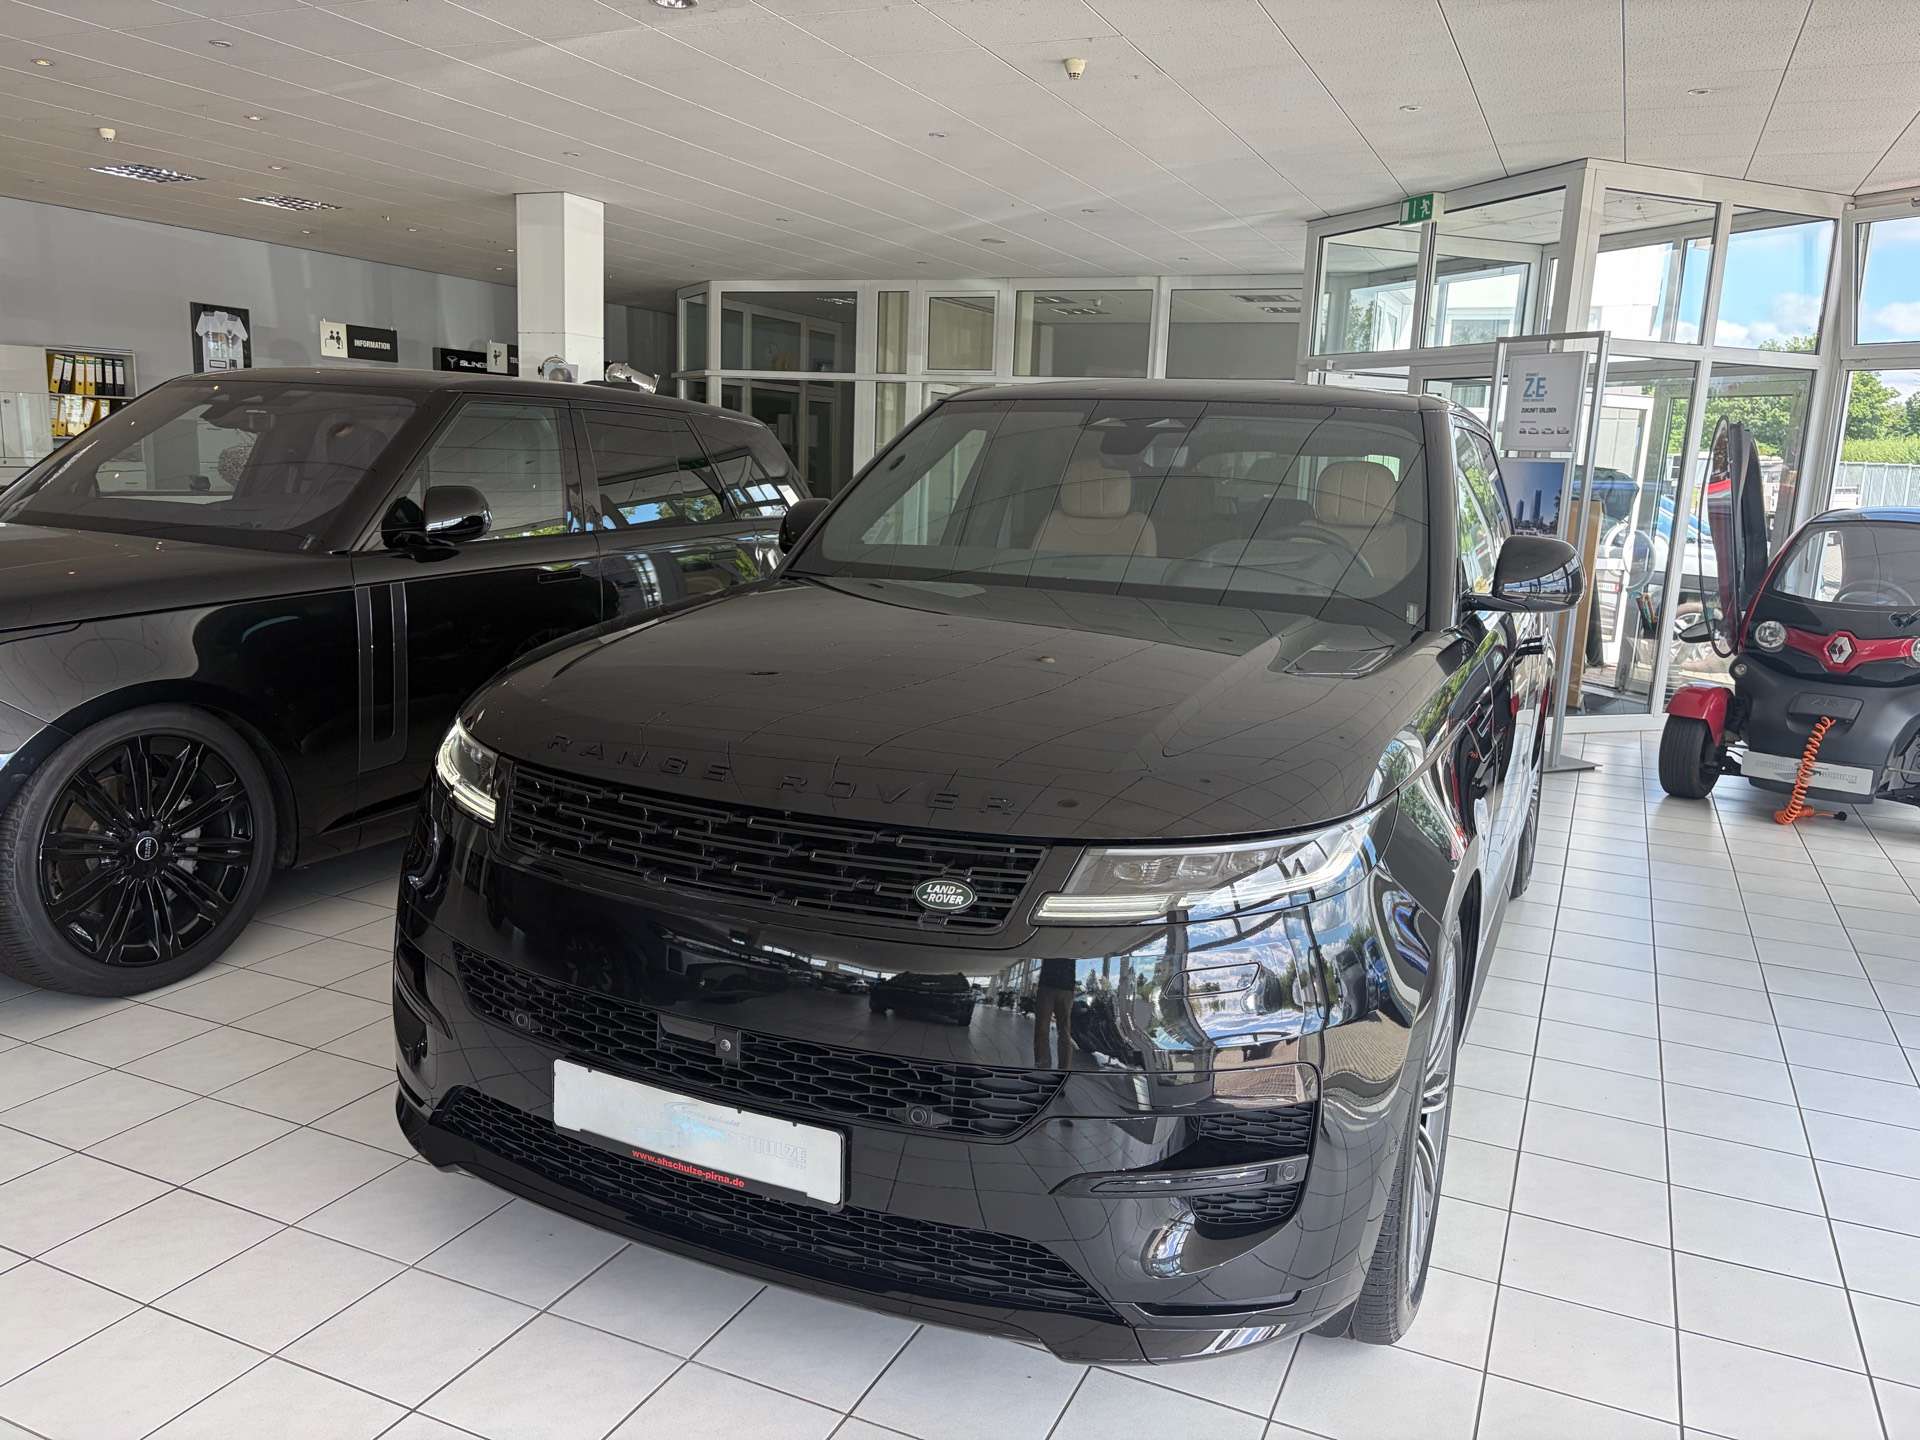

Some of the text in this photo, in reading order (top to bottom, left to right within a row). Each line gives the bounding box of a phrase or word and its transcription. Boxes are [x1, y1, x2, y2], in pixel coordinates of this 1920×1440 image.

[354, 339, 391, 351] INFORMATION
[1523, 377, 1548, 397] Z.E.
[547, 735, 1017, 816] RANGE ROVER
[926, 884, 956, 895] LAND
[927, 893, 964, 905] ROVER
[631, 1149, 745, 1188] www.ahschulze-pirna.de
